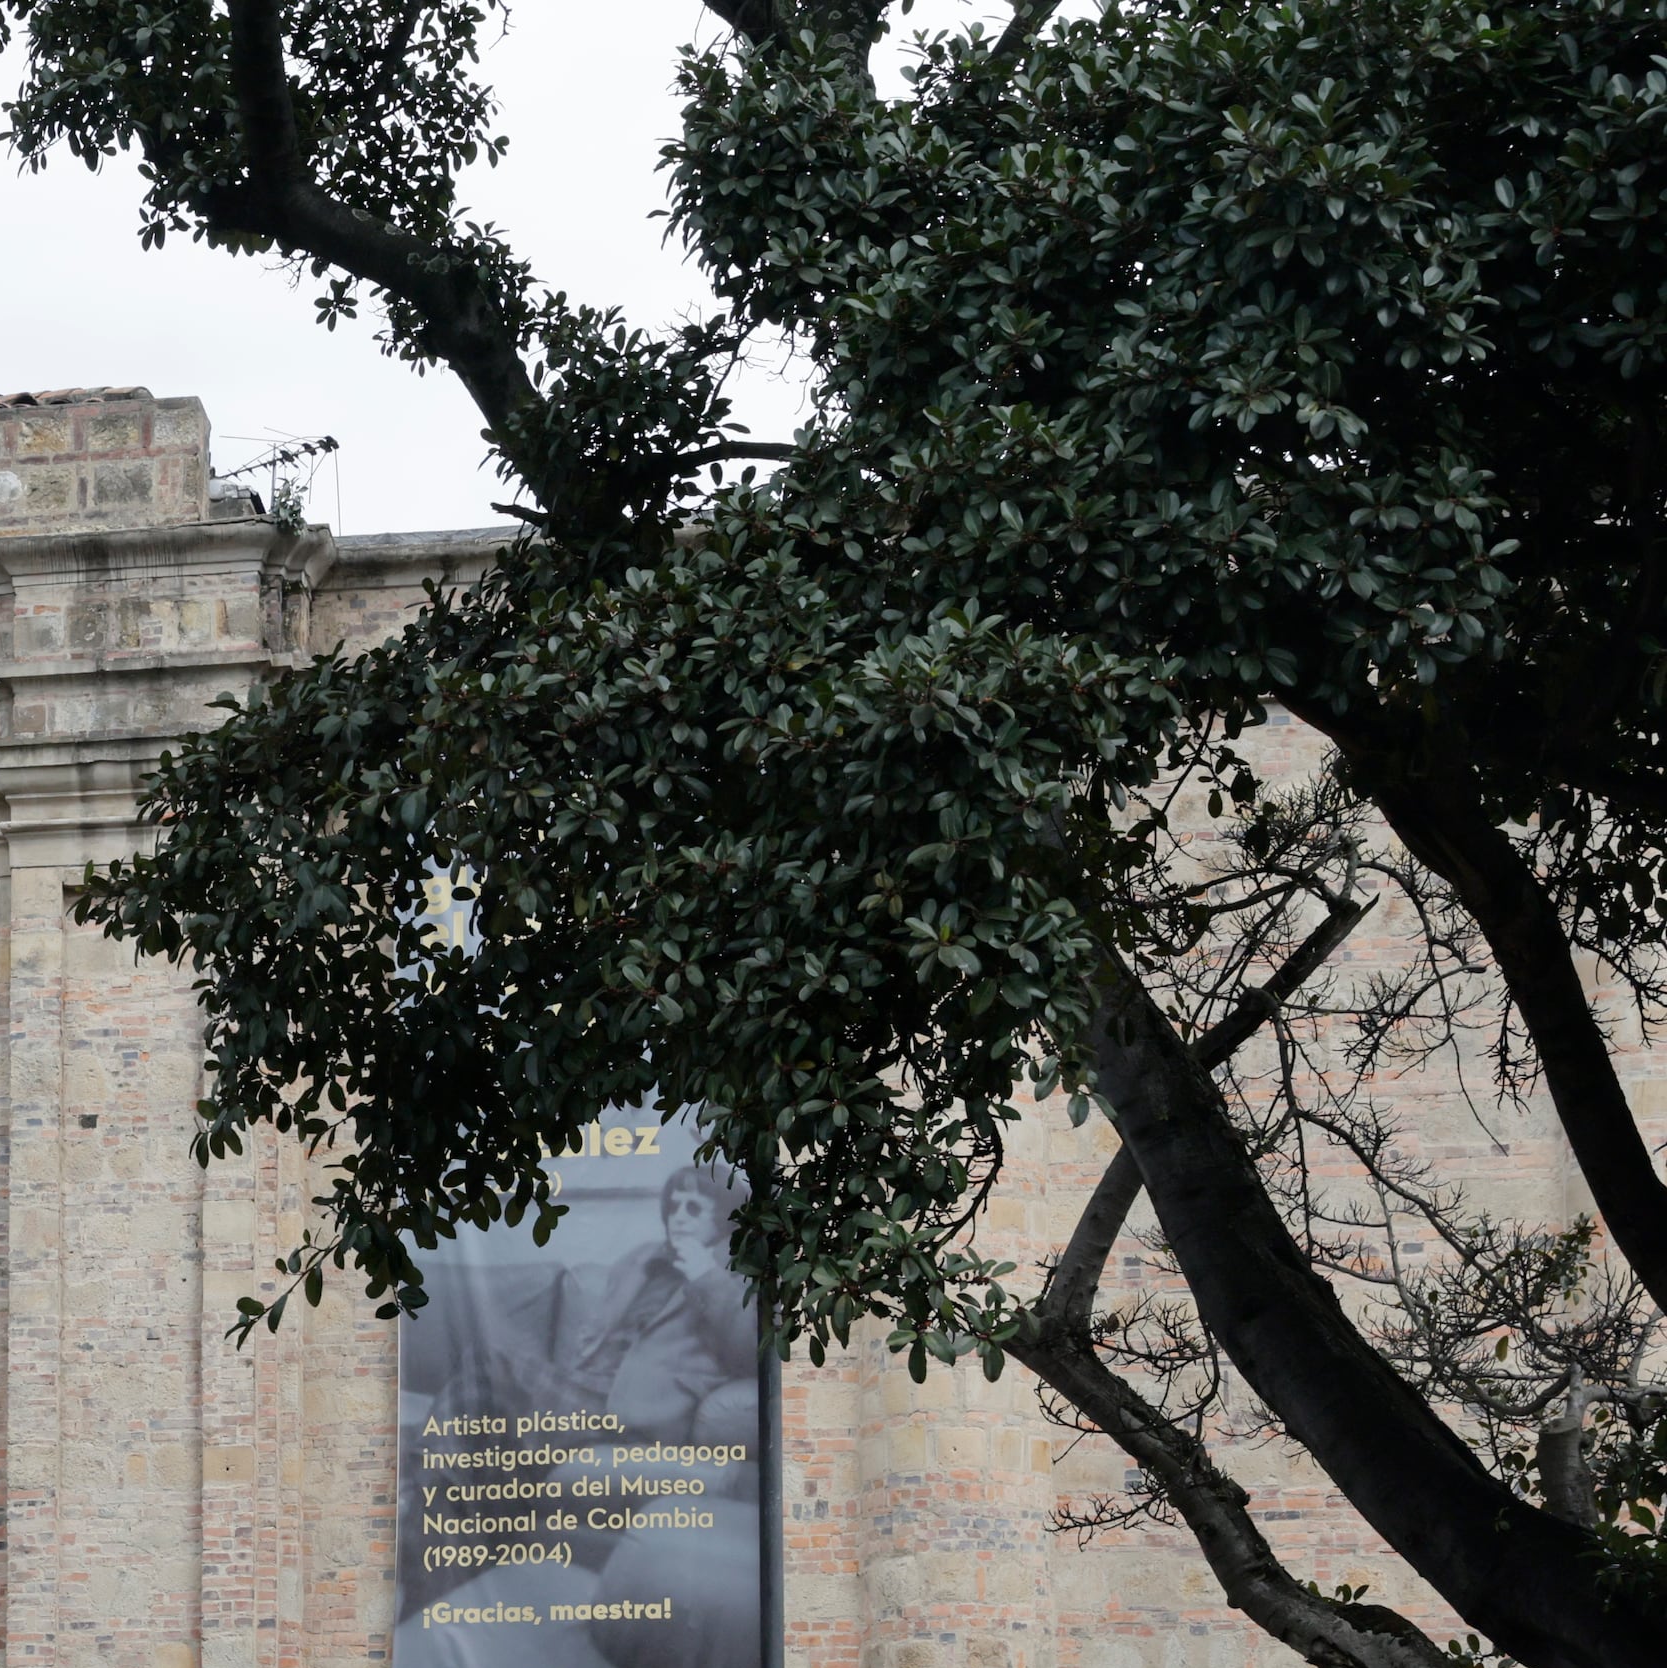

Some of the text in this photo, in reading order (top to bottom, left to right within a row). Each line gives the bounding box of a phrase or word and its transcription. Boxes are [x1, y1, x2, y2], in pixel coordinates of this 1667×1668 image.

[422, 1410, 626, 1437] Artista plástica,
[422, 1441, 746, 1471] investigadora, pedagoga
[422, 1473, 705, 1507] y curadora del Museo
[422, 1506, 714, 1535] Nacional de Colombia
[423, 1542, 572, 1572] (1989-2004)
[423, 1597, 672, 1628] ¡Gracias, maestra!
